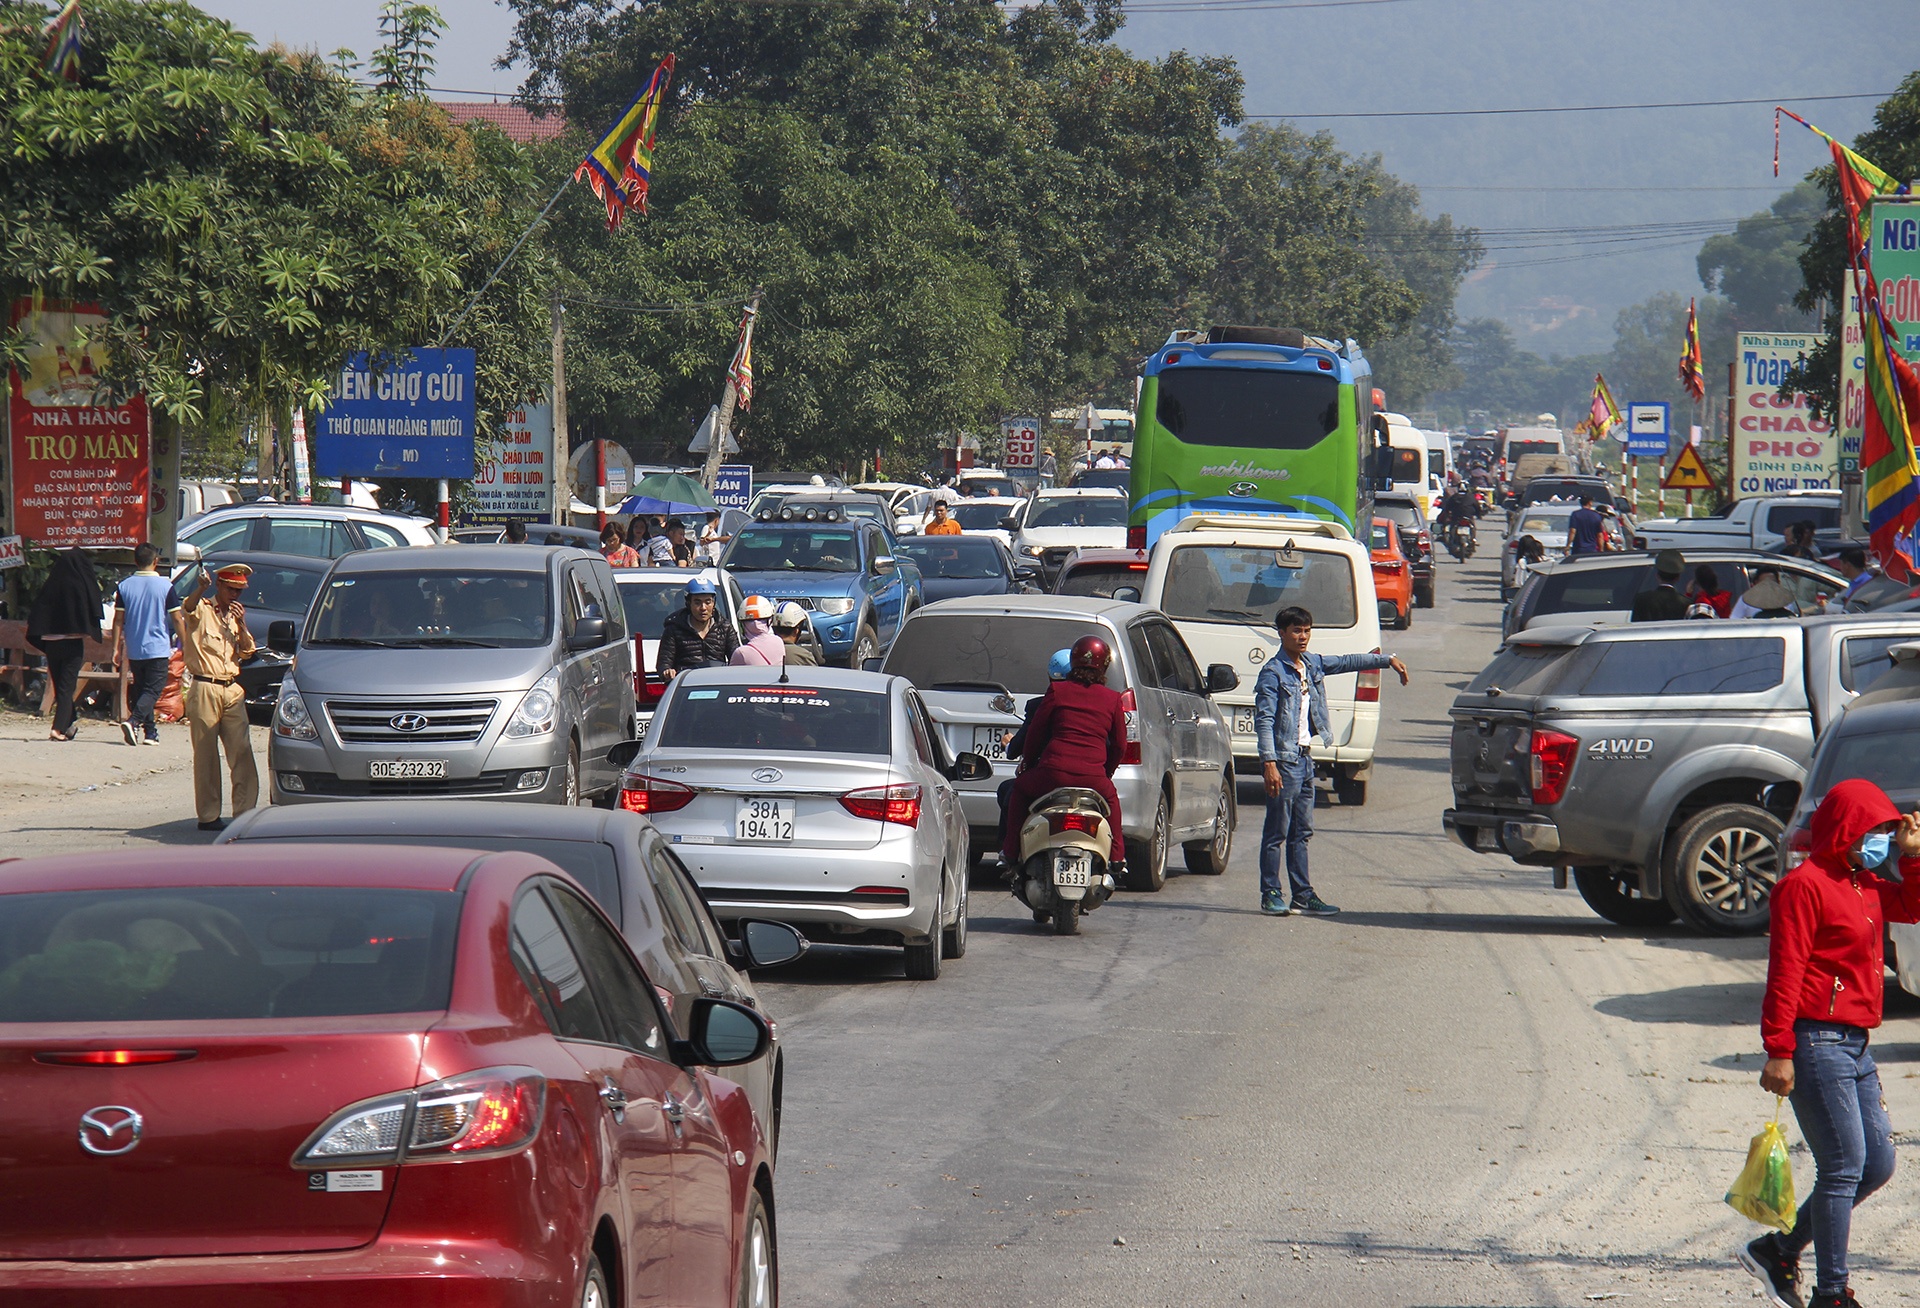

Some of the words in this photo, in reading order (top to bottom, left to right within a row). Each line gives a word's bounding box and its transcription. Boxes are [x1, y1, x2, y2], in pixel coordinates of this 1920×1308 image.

[427, 364, 463, 401] CỦI
[33, 408, 73, 426] NHÀ
[78, 407, 131, 425] HÀNG
[328, 414, 351, 434] THỜ
[353, 418, 386, 436] QUAN
[388, 416, 427, 436] HOÀNG
[431, 415, 462, 436] MƯỜI
[25, 434, 77, 465] TRỢ
[83, 429, 139, 464] MẬN
[50, 469, 71, 479] CƠM
[74, 467, 95, 479] BÌNH
[97, 467, 116, 478] DÂN
[1200, 460, 1291, 481] mobihome
[34, 483, 54, 494] ĐẶC
[56, 482, 76, 492] SẢN
[78, 482, 104, 492] LƯƠN
[23, 496, 50, 510] NHẬN
[51, 496, 69, 509] ĐẶT
[72, 496, 93, 505] CƠM
[123, 494, 142, 505] CƠM
[45, 509, 64, 519] BÚN
[72, 508, 97, 519] CHÁO
[105, 508, 124, 518] PHỞ
[66, 527, 88, 535] 0943
[90, 526, 105, 534] 505
[108, 526, 122, 534] 111
[807, 698, 830, 707] 224
[1588, 738, 1654, 753] 4WD
[750, 801, 780, 820] 38A
[739, 820, 792, 840] 194.12
[1059, 873, 1085, 884] 6633
